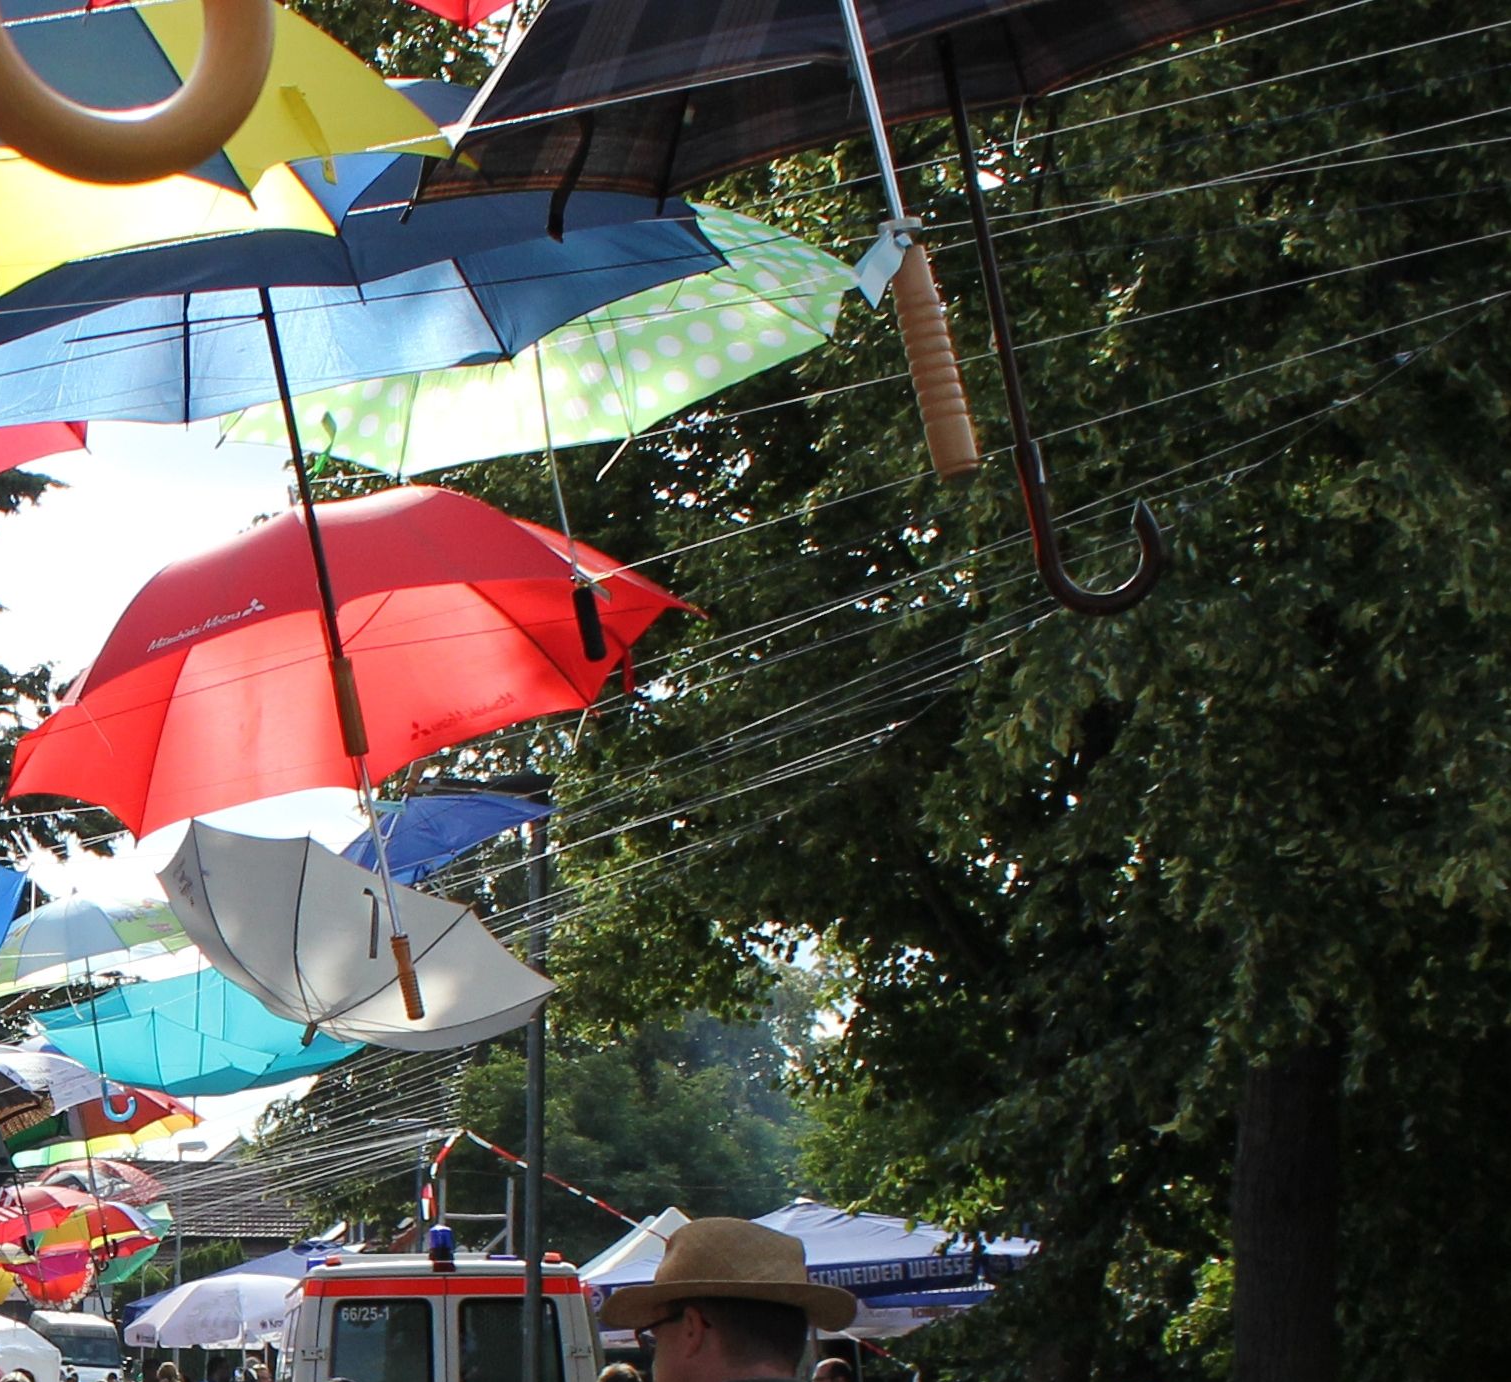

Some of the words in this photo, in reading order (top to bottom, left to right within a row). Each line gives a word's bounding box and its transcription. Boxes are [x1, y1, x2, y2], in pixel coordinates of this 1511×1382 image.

[809, 1263, 903, 1286] SCHNEIDER
[908, 1257, 973, 1279] WEISSE
[341, 1306, 389, 1321] 66/25-1
